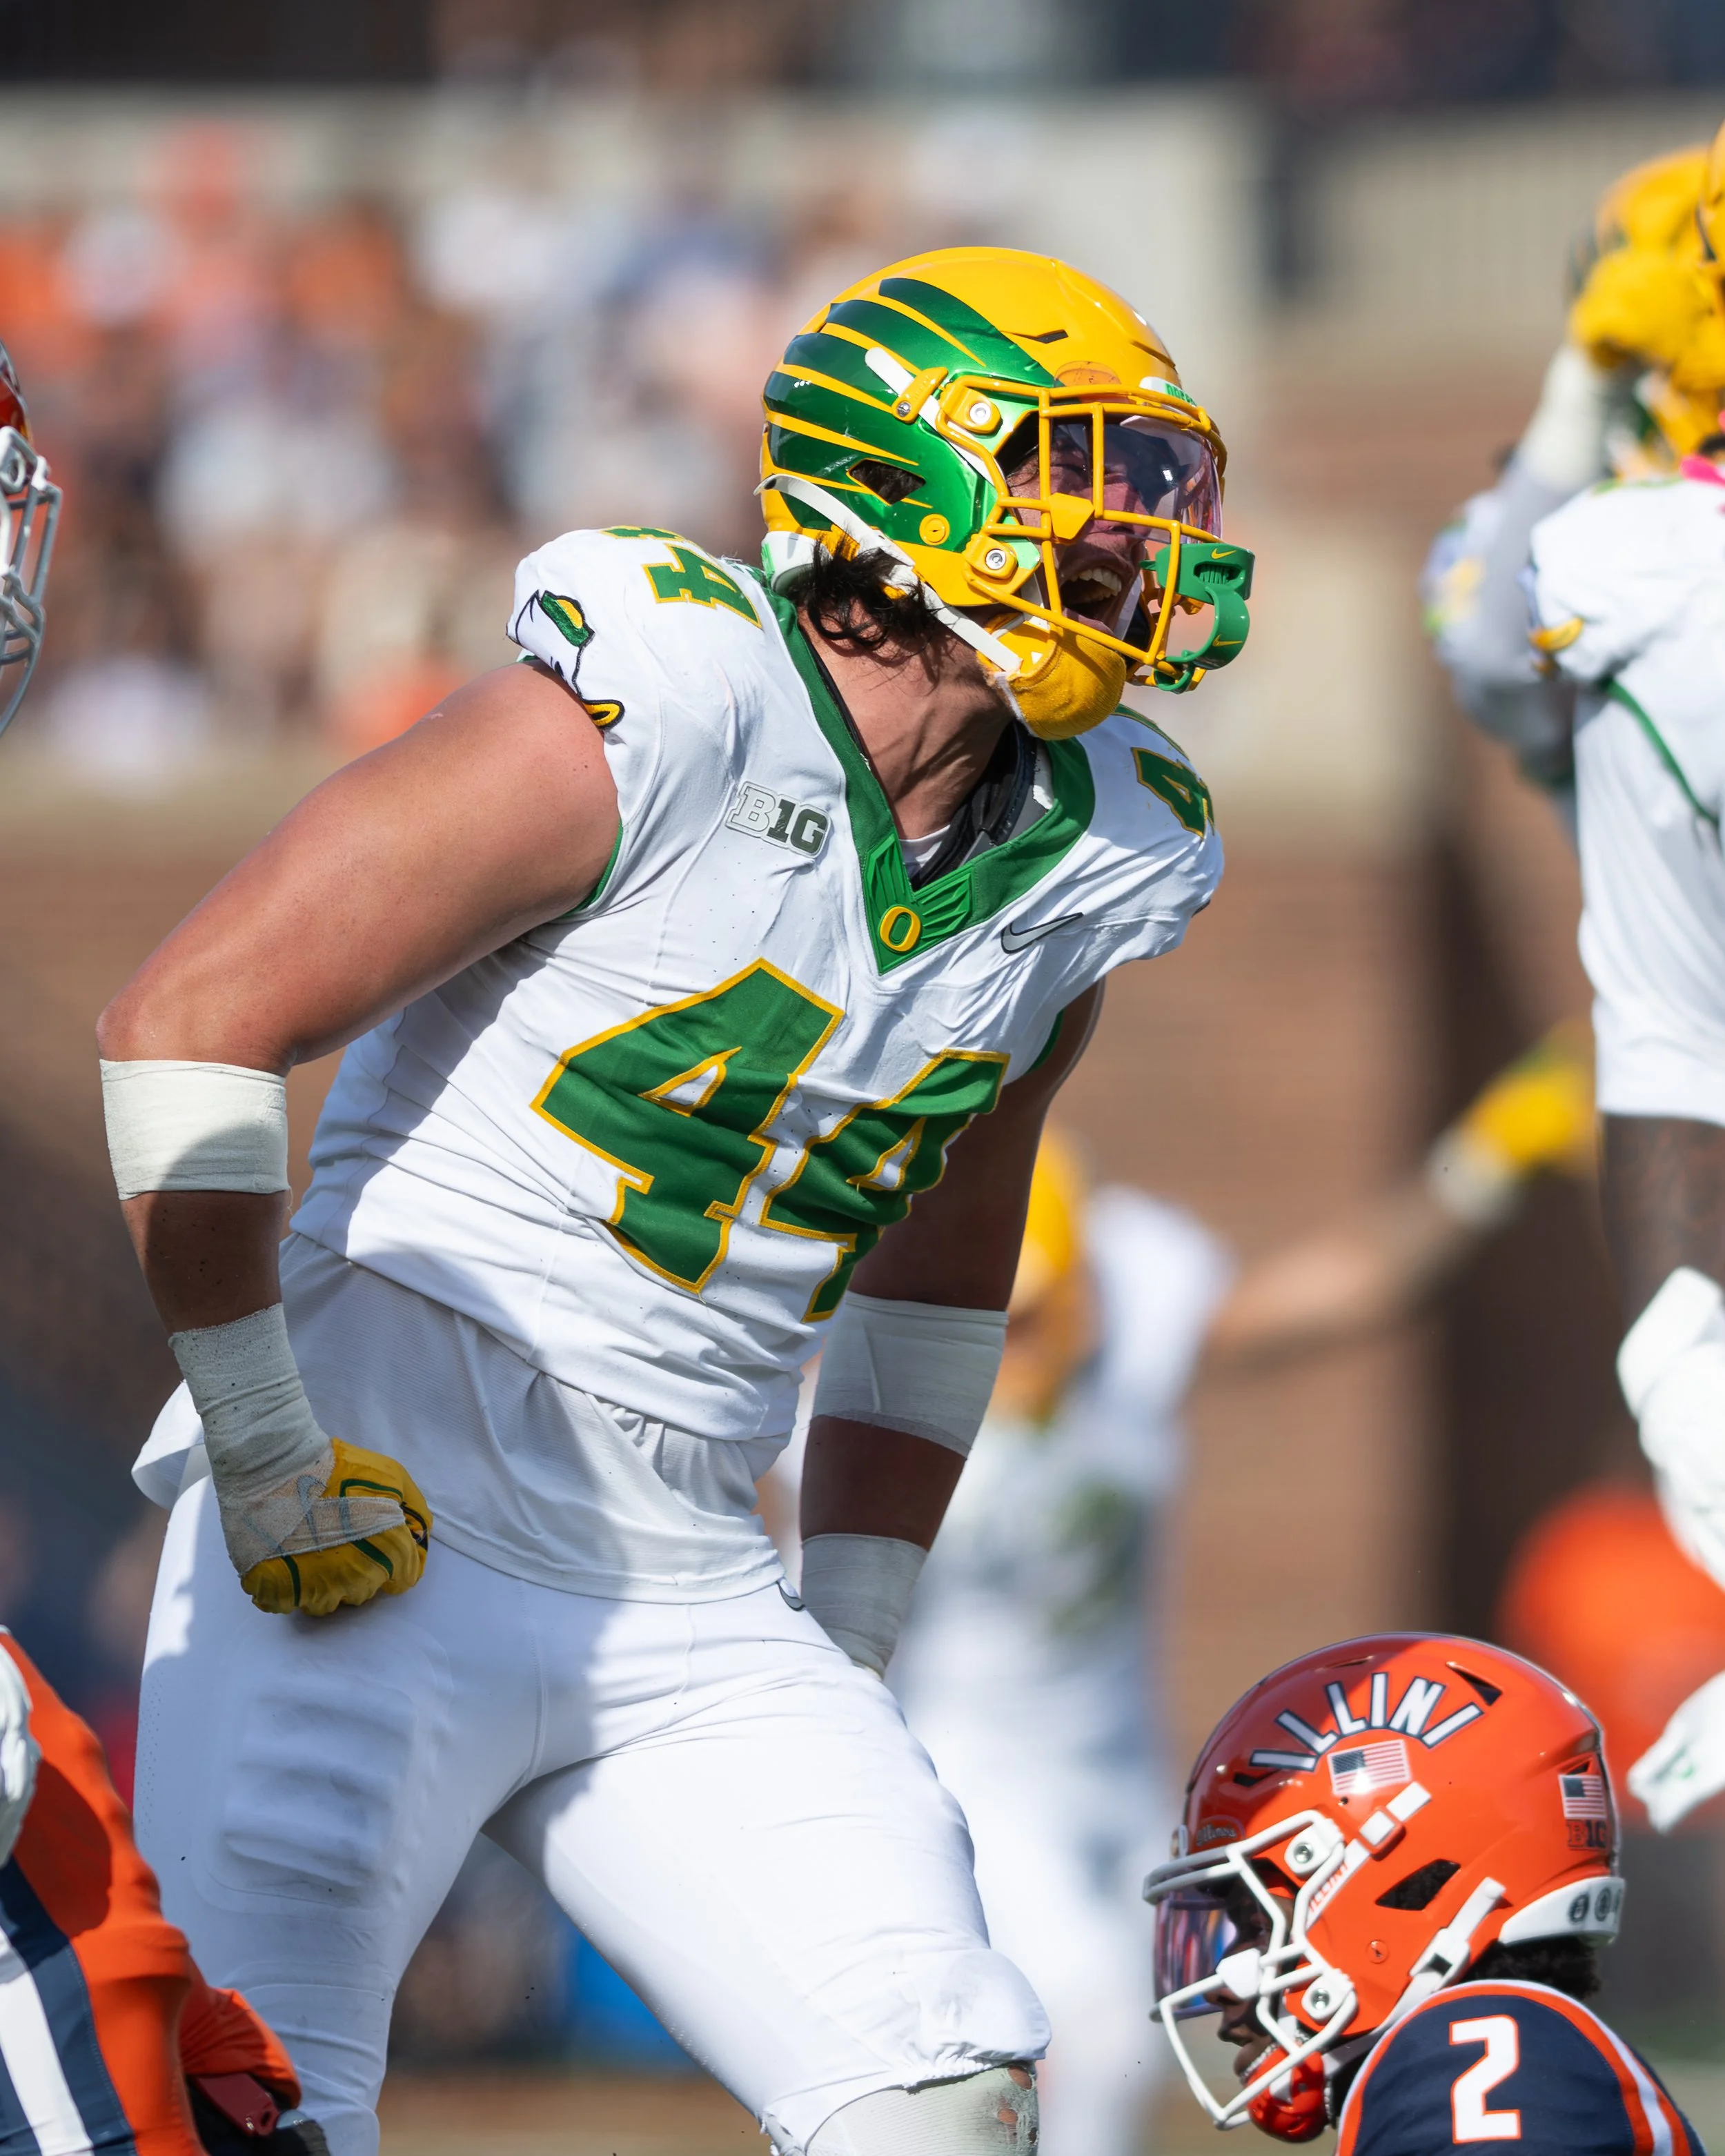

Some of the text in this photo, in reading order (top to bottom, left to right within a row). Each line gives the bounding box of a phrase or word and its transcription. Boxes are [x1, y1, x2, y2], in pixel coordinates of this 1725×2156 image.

[529, 956, 1011, 1324] 44
[1248, 1671, 1485, 1772] ILLINI
[1448, 2015, 1521, 2144] 2
